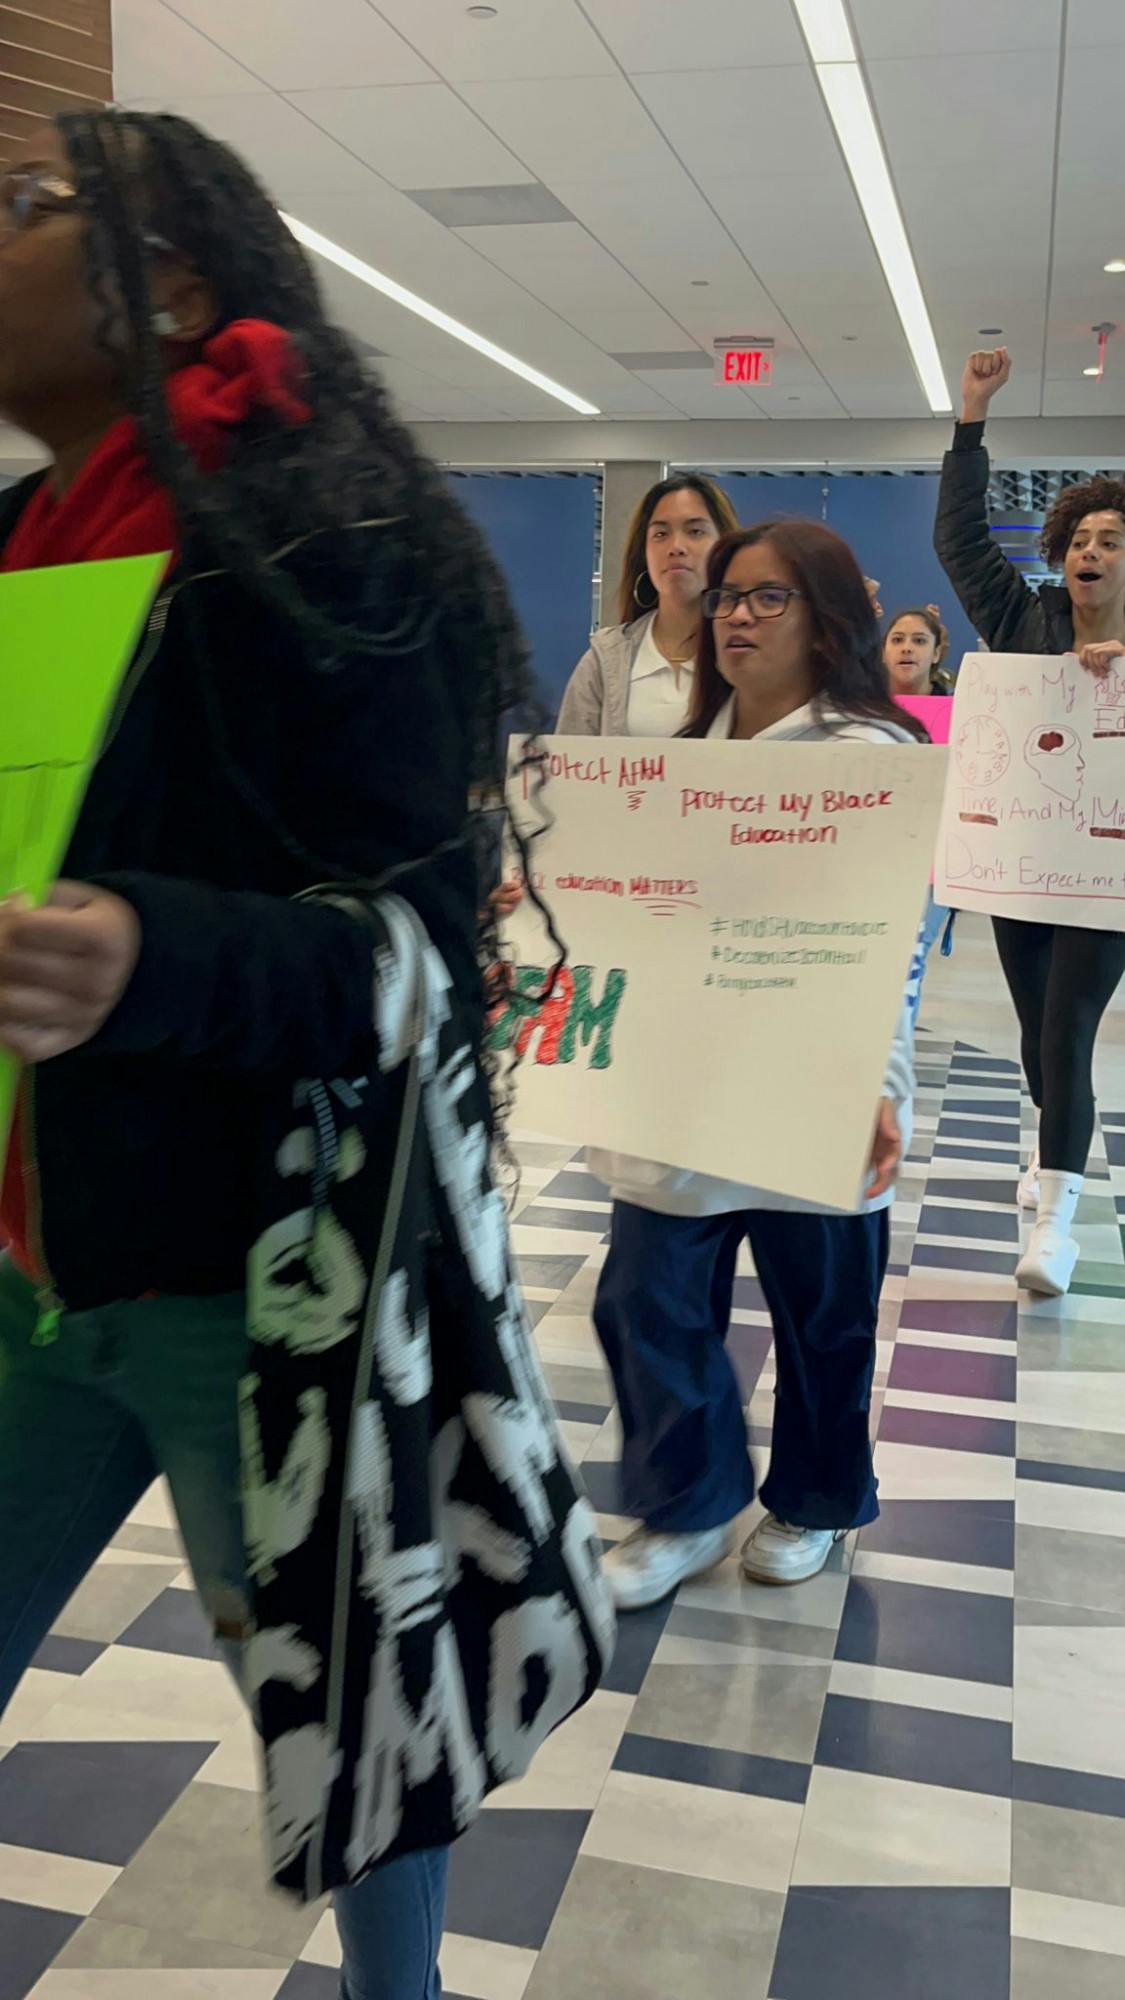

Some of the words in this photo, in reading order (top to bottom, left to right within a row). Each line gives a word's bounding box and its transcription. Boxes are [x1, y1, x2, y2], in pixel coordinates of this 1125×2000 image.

[724, 351, 763, 383] EXIT
[1041, 666, 1076, 713] My
[680, 788, 768, 817] Protect
[1009, 797, 1052, 821] And
[946, 832, 1008, 881] Don't
[1018, 855, 1086, 893] Expect
[1092, 875, 1113, 887] me
